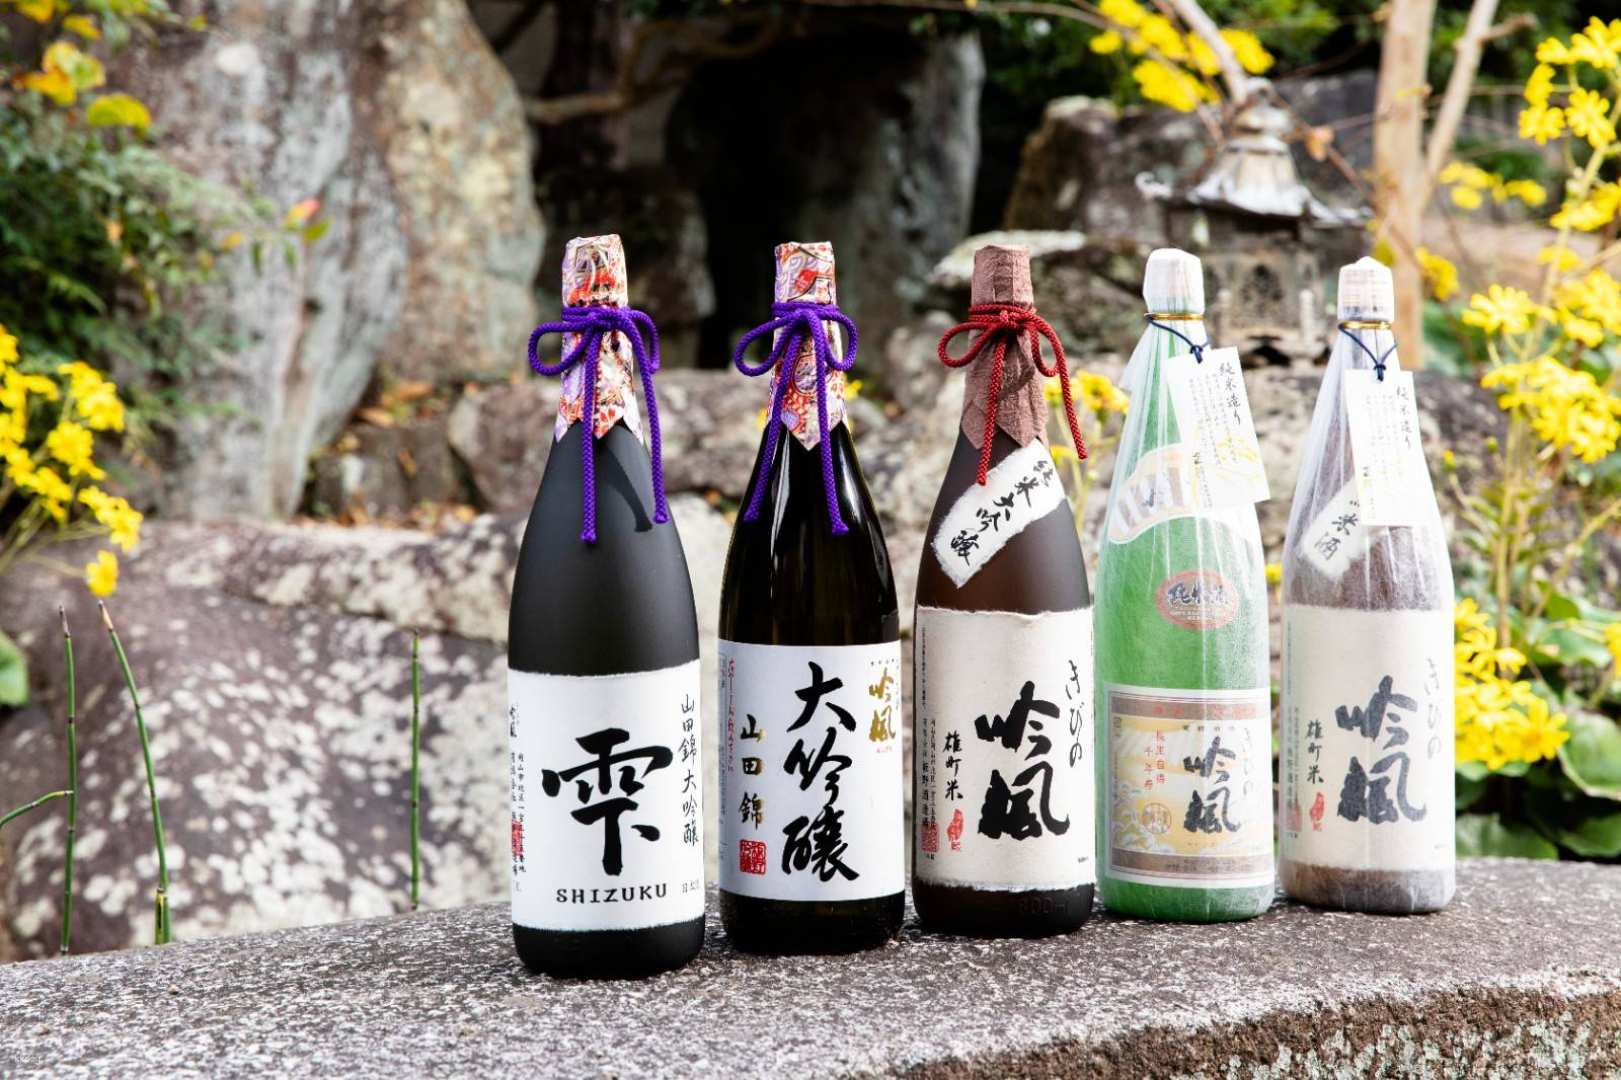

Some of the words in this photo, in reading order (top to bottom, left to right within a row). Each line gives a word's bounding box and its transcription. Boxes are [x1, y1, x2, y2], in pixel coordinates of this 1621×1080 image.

[1314, 501, 1360, 560] 米酒
[678, 694, 699, 847] 山田錦大吟醸
[943, 730, 963, 801] 雄町米
[974, 681, 1070, 842] 吟風
[1065, 660, 1083, 769] きびの
[1305, 719, 1324, 784] 雄町米
[1335, 675, 1427, 825] 吟風
[541, 727, 674, 877] 雫
[739, 714, 765, 830] 山田錦
[782, 661, 860, 882] 大吟醸
[1183, 735, 1241, 834] 吟風
[556, 883, 668, 904] SHIZUKU
